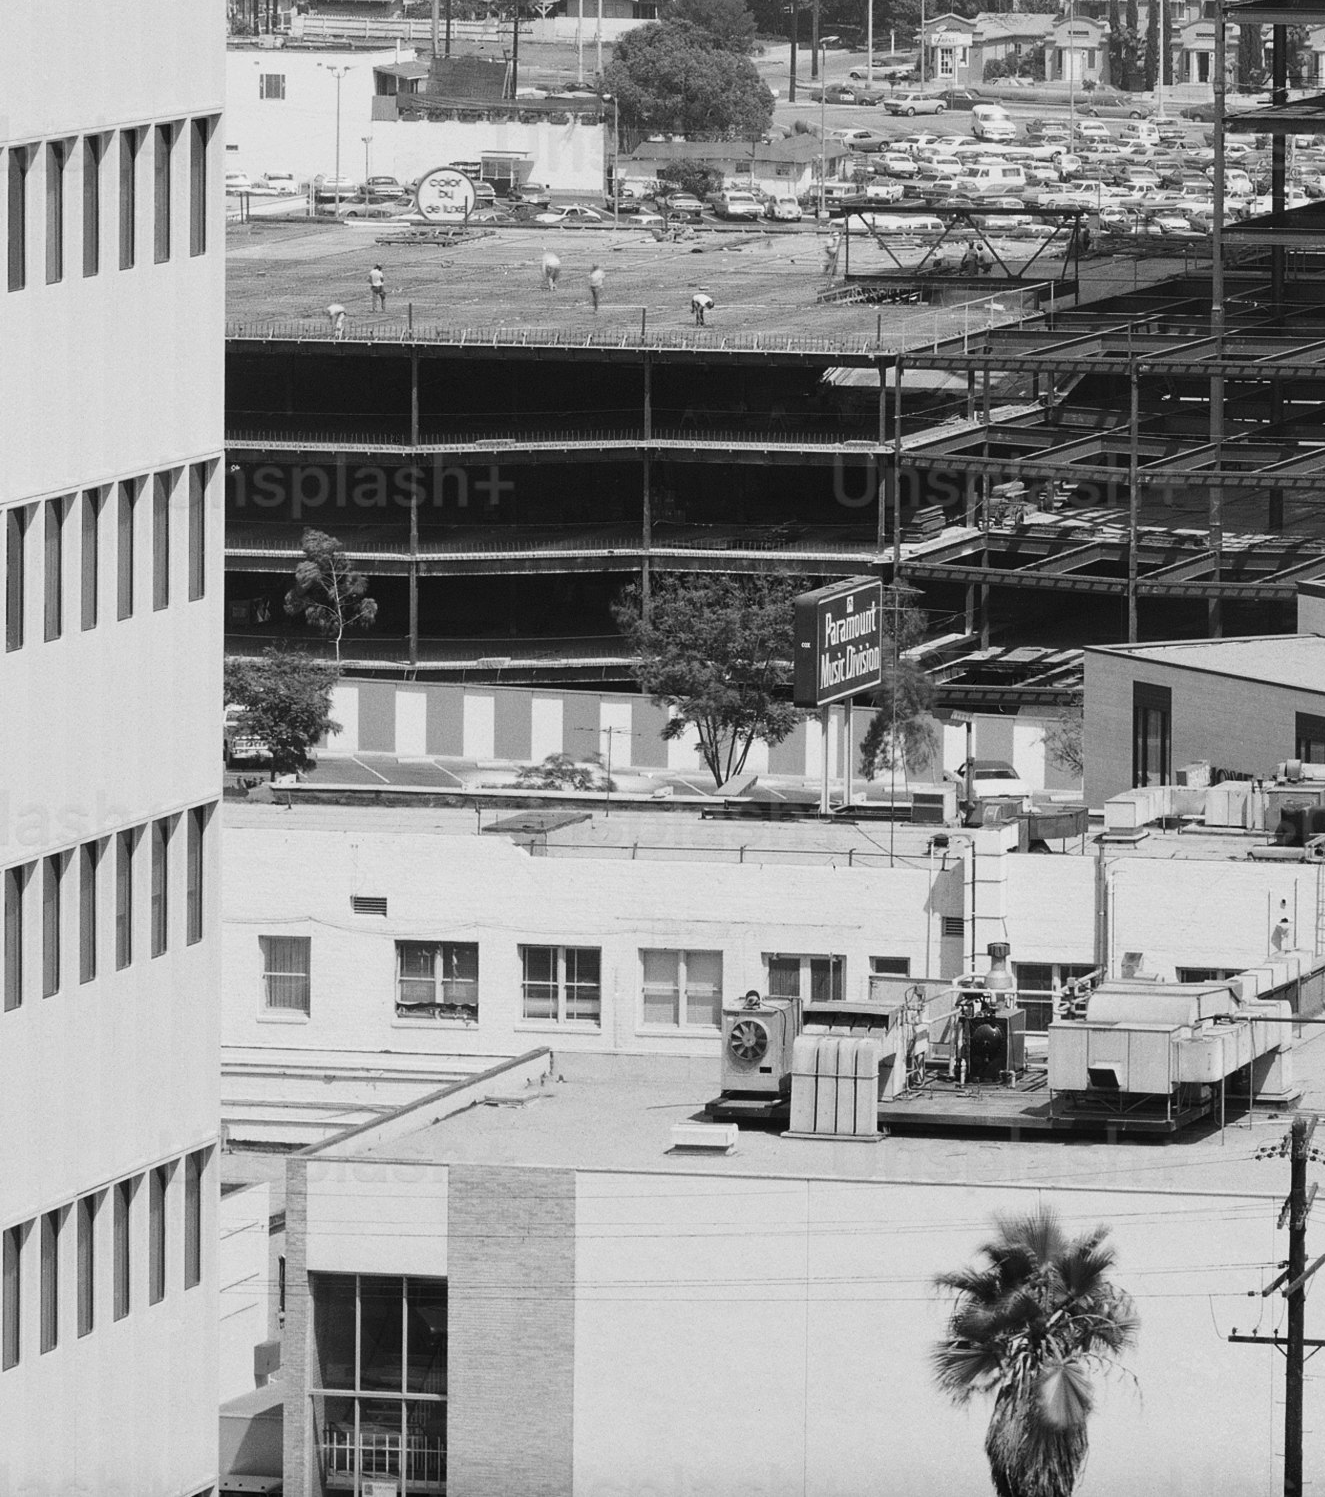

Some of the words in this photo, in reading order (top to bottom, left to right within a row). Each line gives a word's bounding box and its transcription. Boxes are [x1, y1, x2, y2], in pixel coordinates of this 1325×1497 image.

[429, 177, 462, 188] color
[438, 189, 454, 200] by
[425, 204, 440, 214] de
[825, 601, 877, 648] Paramount
[820, 652, 846, 690] Music
[846, 642, 880, 681] Division
